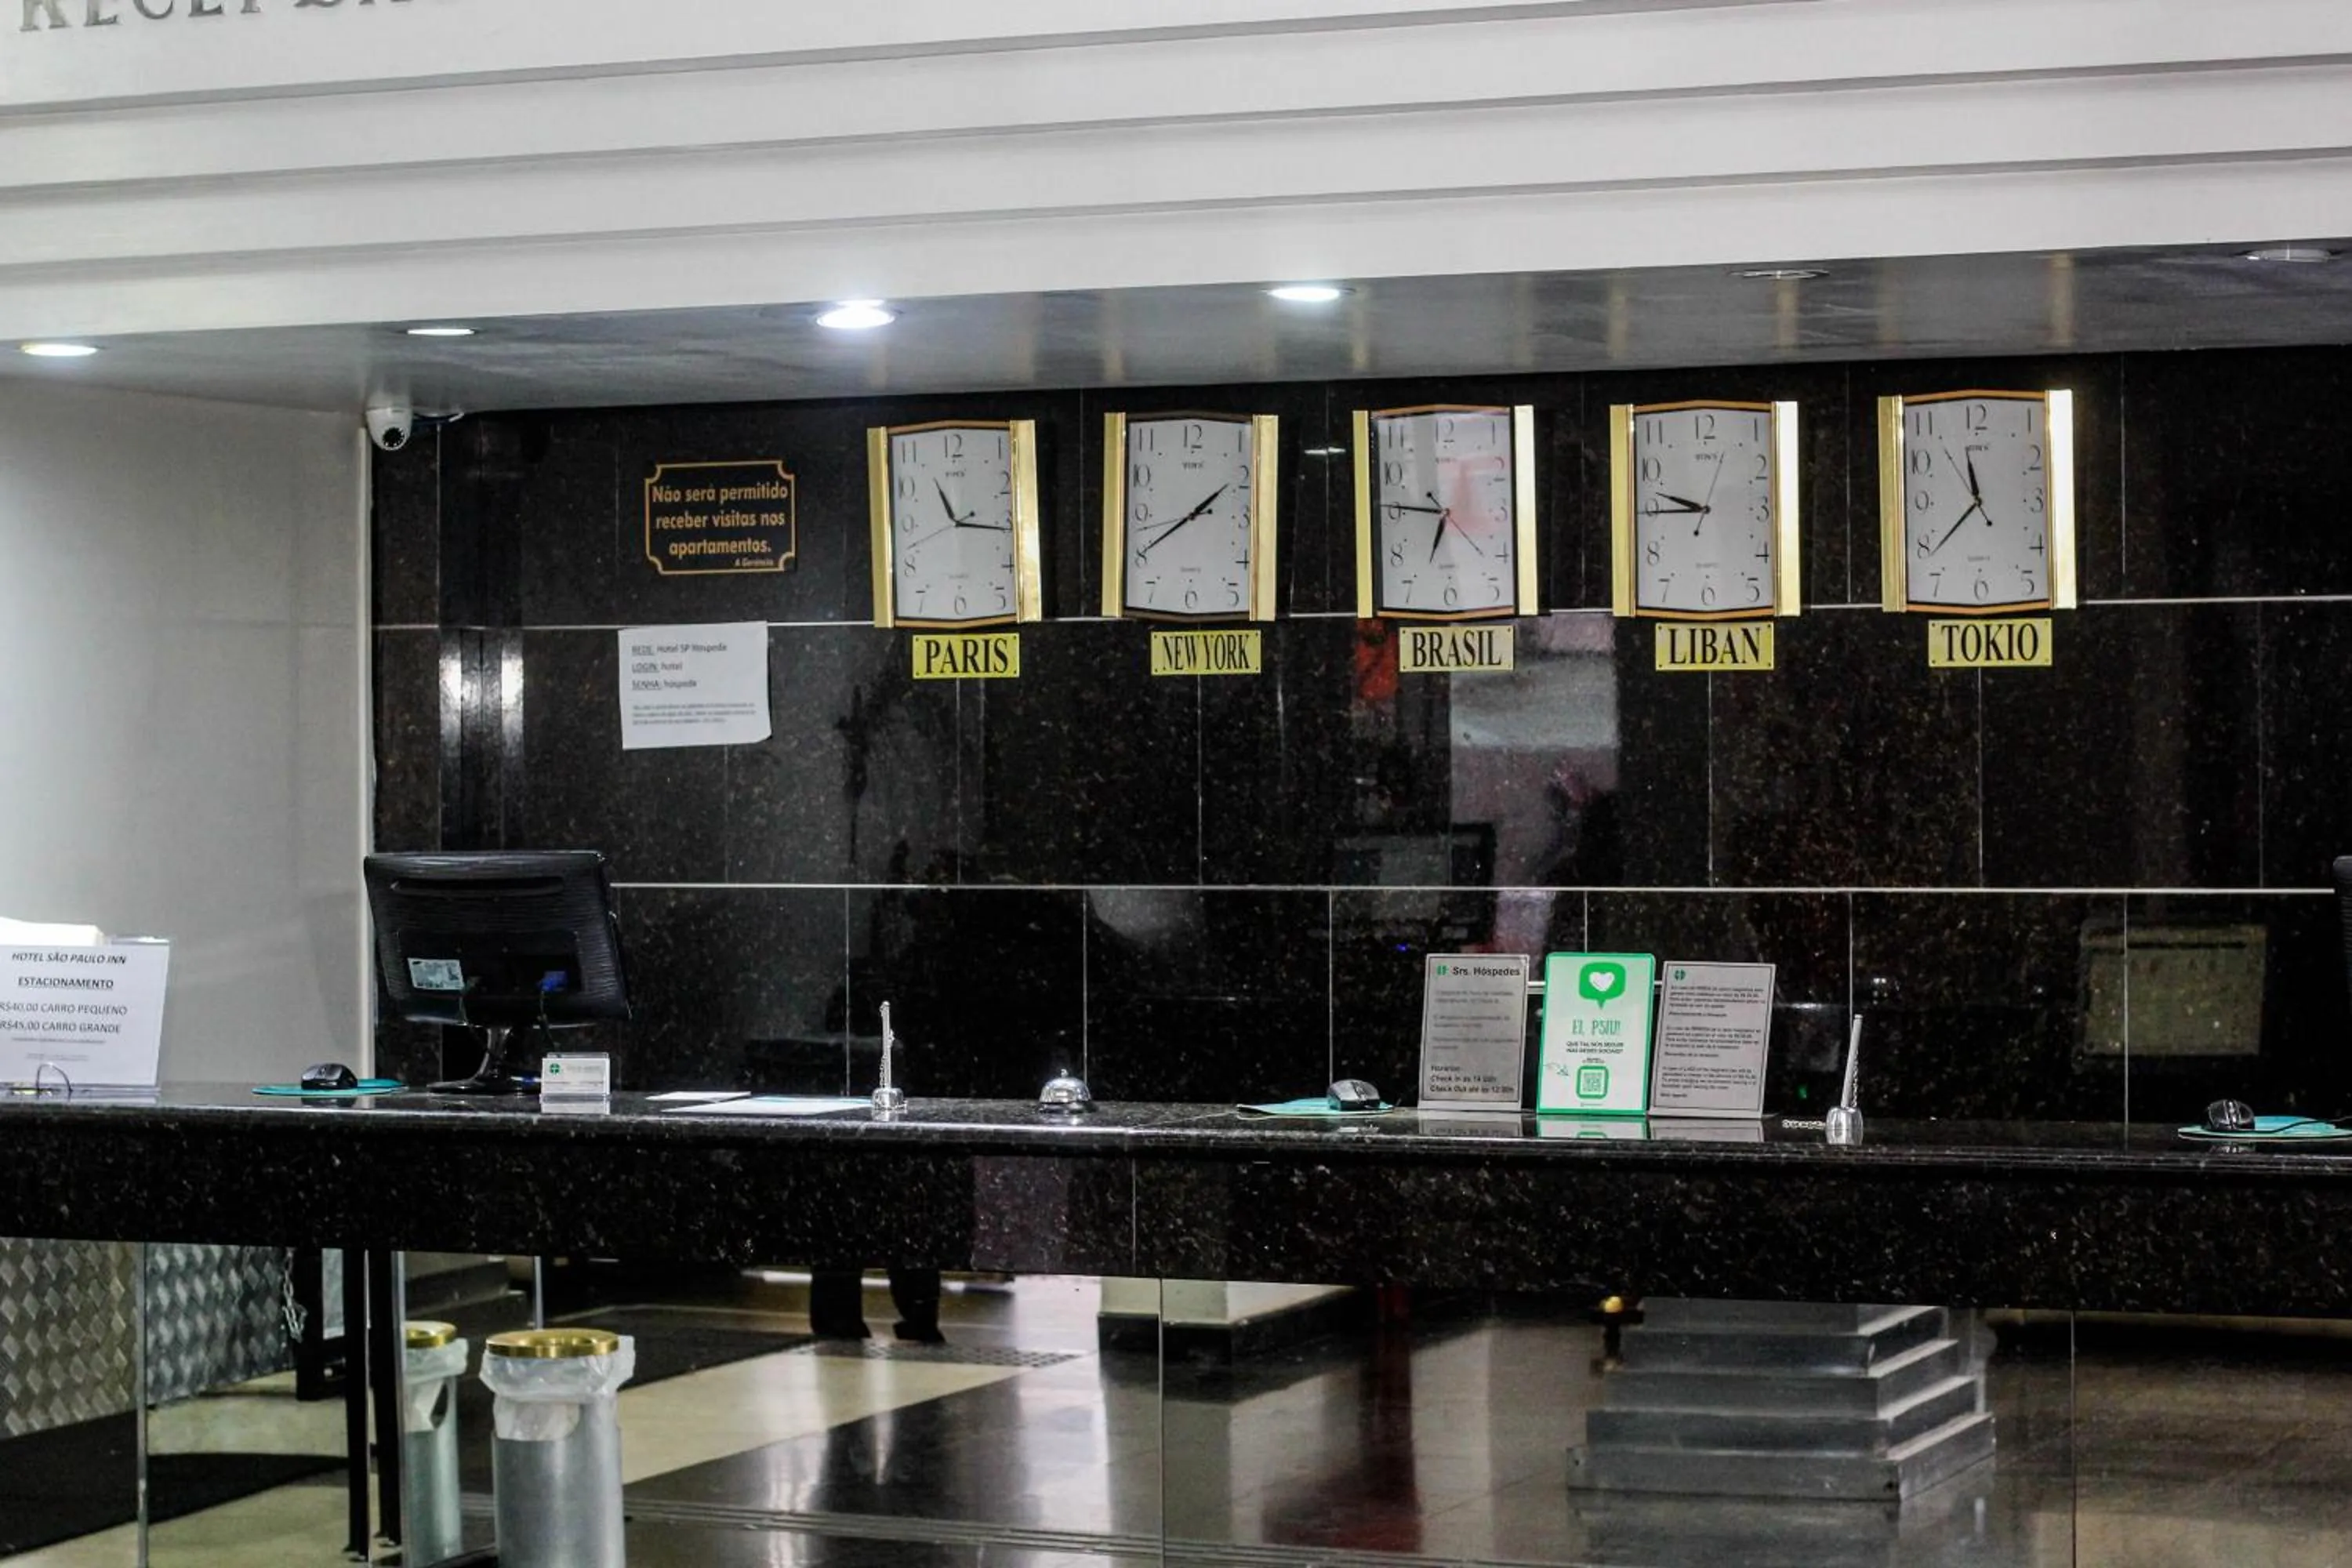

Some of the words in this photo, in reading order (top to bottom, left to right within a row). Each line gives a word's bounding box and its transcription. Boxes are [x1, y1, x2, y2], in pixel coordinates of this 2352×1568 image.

[1695, 414, 1715, 440] 12
[1754, 417, 1758, 441] 1
[1915, 410, 1933, 436] 11
[1966, 404, 1987, 430] 12
[2027, 408, 2031, 434] 1
[1139, 428, 1152, 452] 11
[1184, 424, 1203, 448] 12
[1238, 430, 1242, 452] 1
[1388, 425, 1404, 448] 11
[1436, 419, 1454, 443] 12
[1492, 421, 1496, 445] 1
[1647, 419, 1663, 444] 11
[902, 441, 916, 463] 11
[945, 434, 964, 458] 12
[997, 436, 1001, 459] 1
[2028, 445, 2042, 470] 2
[1385, 460, 1403, 486] 10
[1642, 456, 1661, 483] 10
[1755, 454, 1768, 479] 2
[1911, 448, 1931, 475] 10
[898, 476, 915, 499] 10
[1000, 470, 1011, 494] 2
[1133, 464, 1150, 488] 10
[652, 485, 681, 503] Não
[685, 483, 716, 501] será
[720, 481, 788, 505] permitido
[2030, 487, 2043, 513] 3
[656, 510, 708, 529] receber
[713, 510, 757, 528] visitas
[760, 512, 786, 526] nos
[1238, 505, 1250, 529] 3
[1388, 501, 1401, 521] 9
[1494, 499, 1508, 522] 3
[1755, 497, 1769, 523] 3
[902, 514, 915, 534] 9
[669, 536, 772, 560] apartamentos.
[1390, 543, 1403, 568] 8
[1494, 542, 1508, 564] 4
[1646, 540, 1660, 566] 8
[1755, 542, 1769, 564] 4
[1917, 534, 1930, 560] 8
[2029, 534, 2044, 557] 4
[904, 556, 916, 578] 8
[1001, 554, 1014, 573] 4
[1236, 550, 1249, 571] 4
[1145, 581, 1156, 604] 7
[1402, 579, 1414, 603] 7
[1658, 579, 1670, 603] 7
[1746, 577, 1760, 603] 5
[1929, 572, 1941, 597] 7
[2020, 570, 2034, 596] 5
[915, 590, 926, 614] 7
[995, 586, 1006, 610] 5
[1162, 635, 1200, 670] NEW
[1203, 633, 1250, 670] YORK
[1412, 630, 1501, 667] BRASIL
[1668, 627, 1762, 665] LIBAN
[1940, 622, 2038, 662] TOKIO
[924, 637, 1008, 674] PARIS
[12, 953, 44, 962] HOTEL
[45, 951, 68, 964] SÃO
[71, 954, 105, 964] PAULO
[107, 956, 127, 964] INN
[18, 976, 114, 990] ESTACIONAMENTO
[41, 1003, 76, 1014] CARRO
[78, 1004, 128, 1017] PEQUENO
[42, 1021, 77, 1032] CARRO
[78, 1022, 122, 1034] GRANDE
